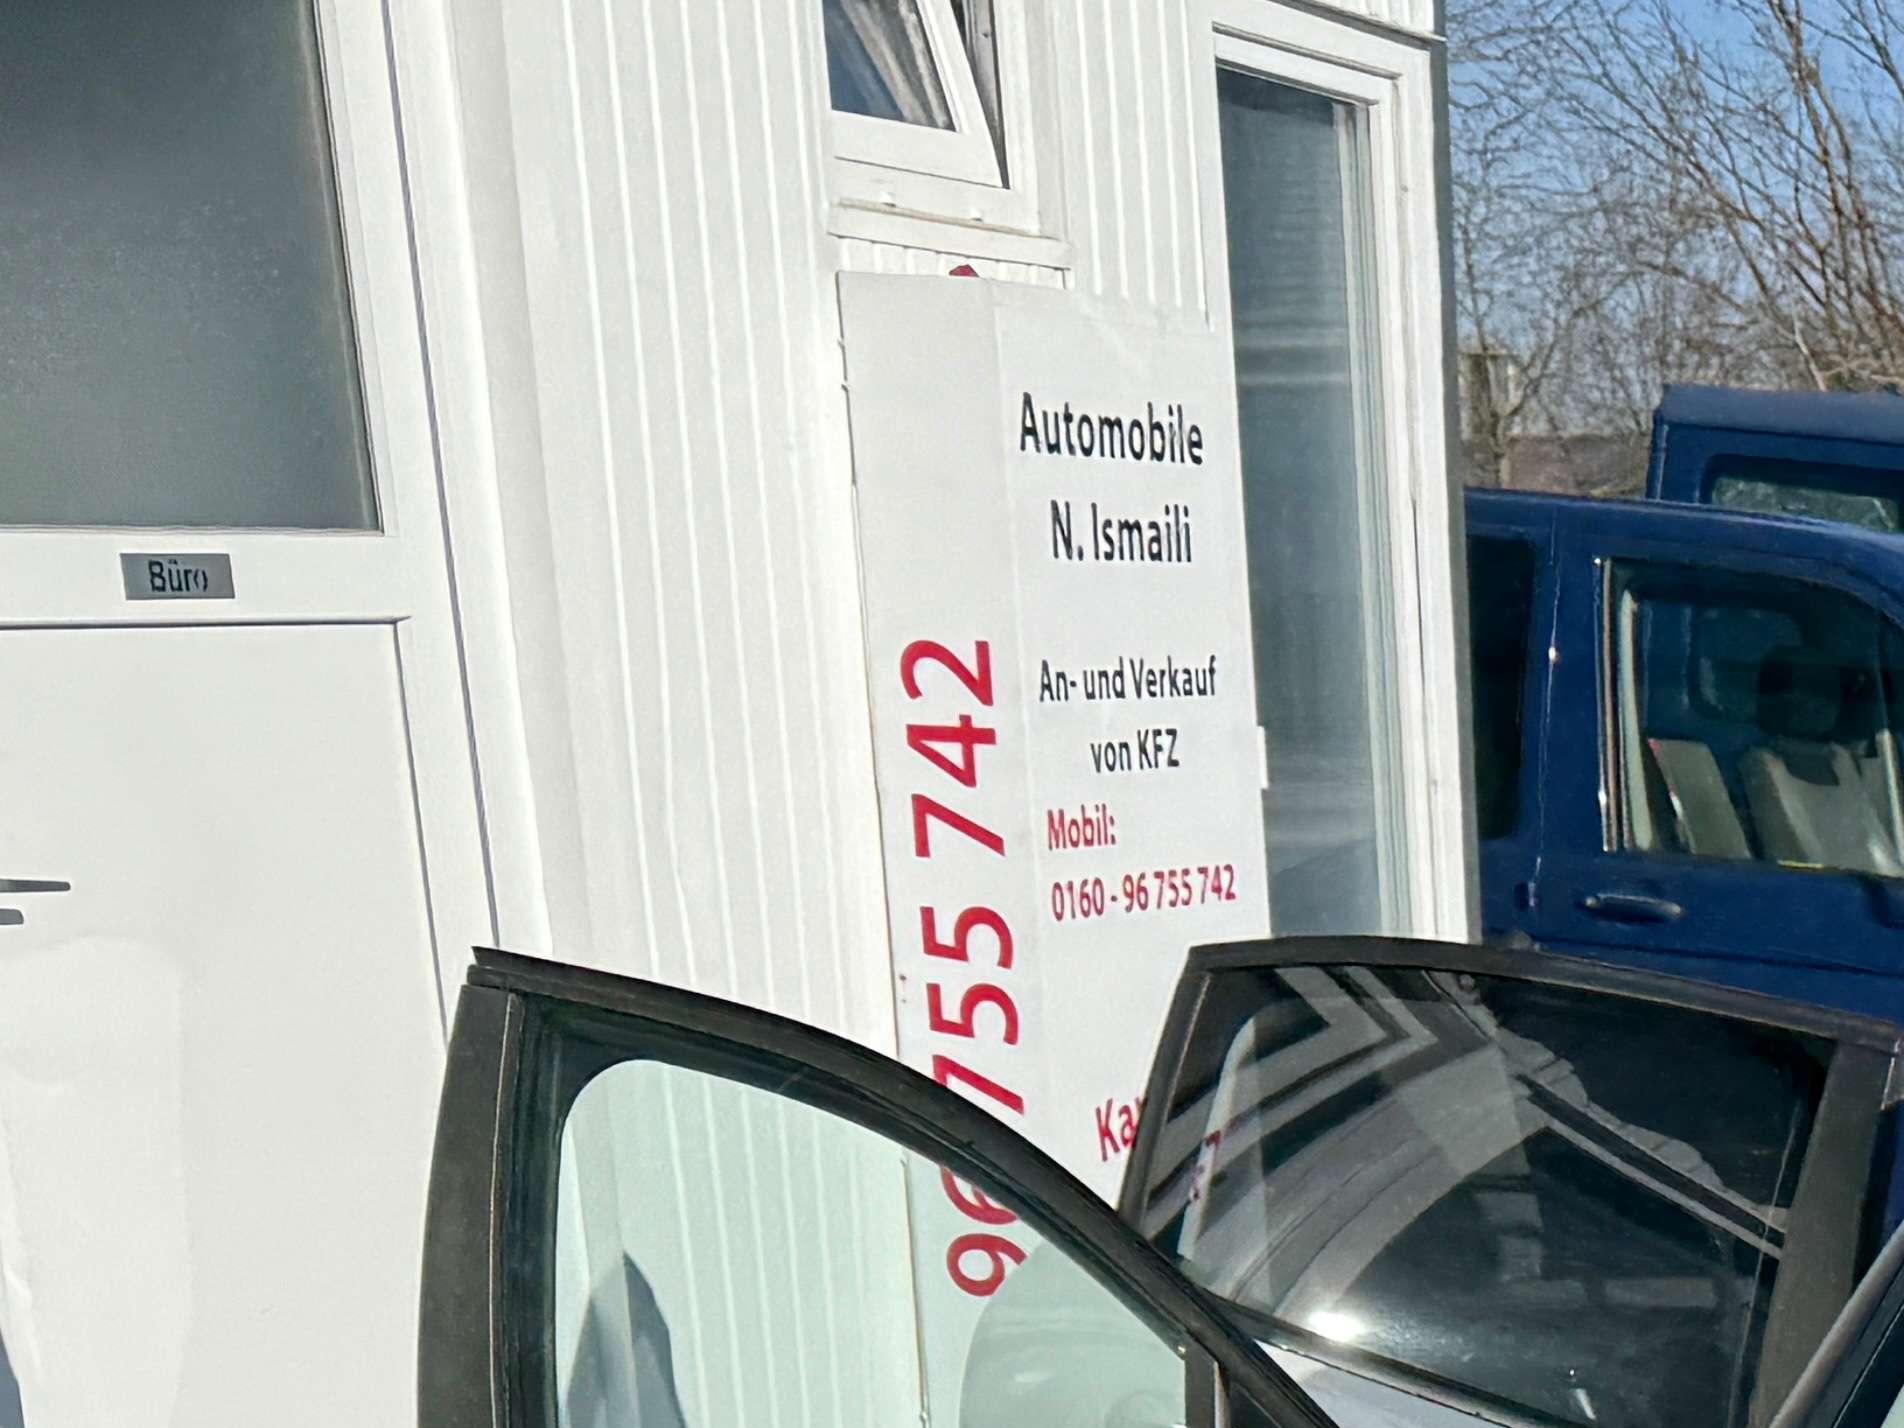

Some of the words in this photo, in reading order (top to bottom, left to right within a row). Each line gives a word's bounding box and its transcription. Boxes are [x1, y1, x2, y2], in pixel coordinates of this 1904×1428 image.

[1020, 391, 1203, 466] Automobile
[1051, 499, 1084, 561] N.
[1091, 502, 1192, 563] Ismaili
[147, 558, 208, 593] Büro
[1039, 659, 1077, 702] An-
[1083, 656, 1126, 700] und
[1130, 654, 1216, 699] Verkauf
[901, 639, 1006, 858] 742
[1090, 741, 1131, 773] von
[1137, 728, 1180, 770] KFZ
[1047, 803, 1116, 851] Mobil:
[1051, 877, 1105, 922] 0160
[1123, 872, 1149, 913] 96
[1153, 868, 1193, 909] 755
[1196, 864, 1236, 904] 742
[920, 904, 1025, 1116] 755
[1096, 1097, 1148, 1162] Ka
